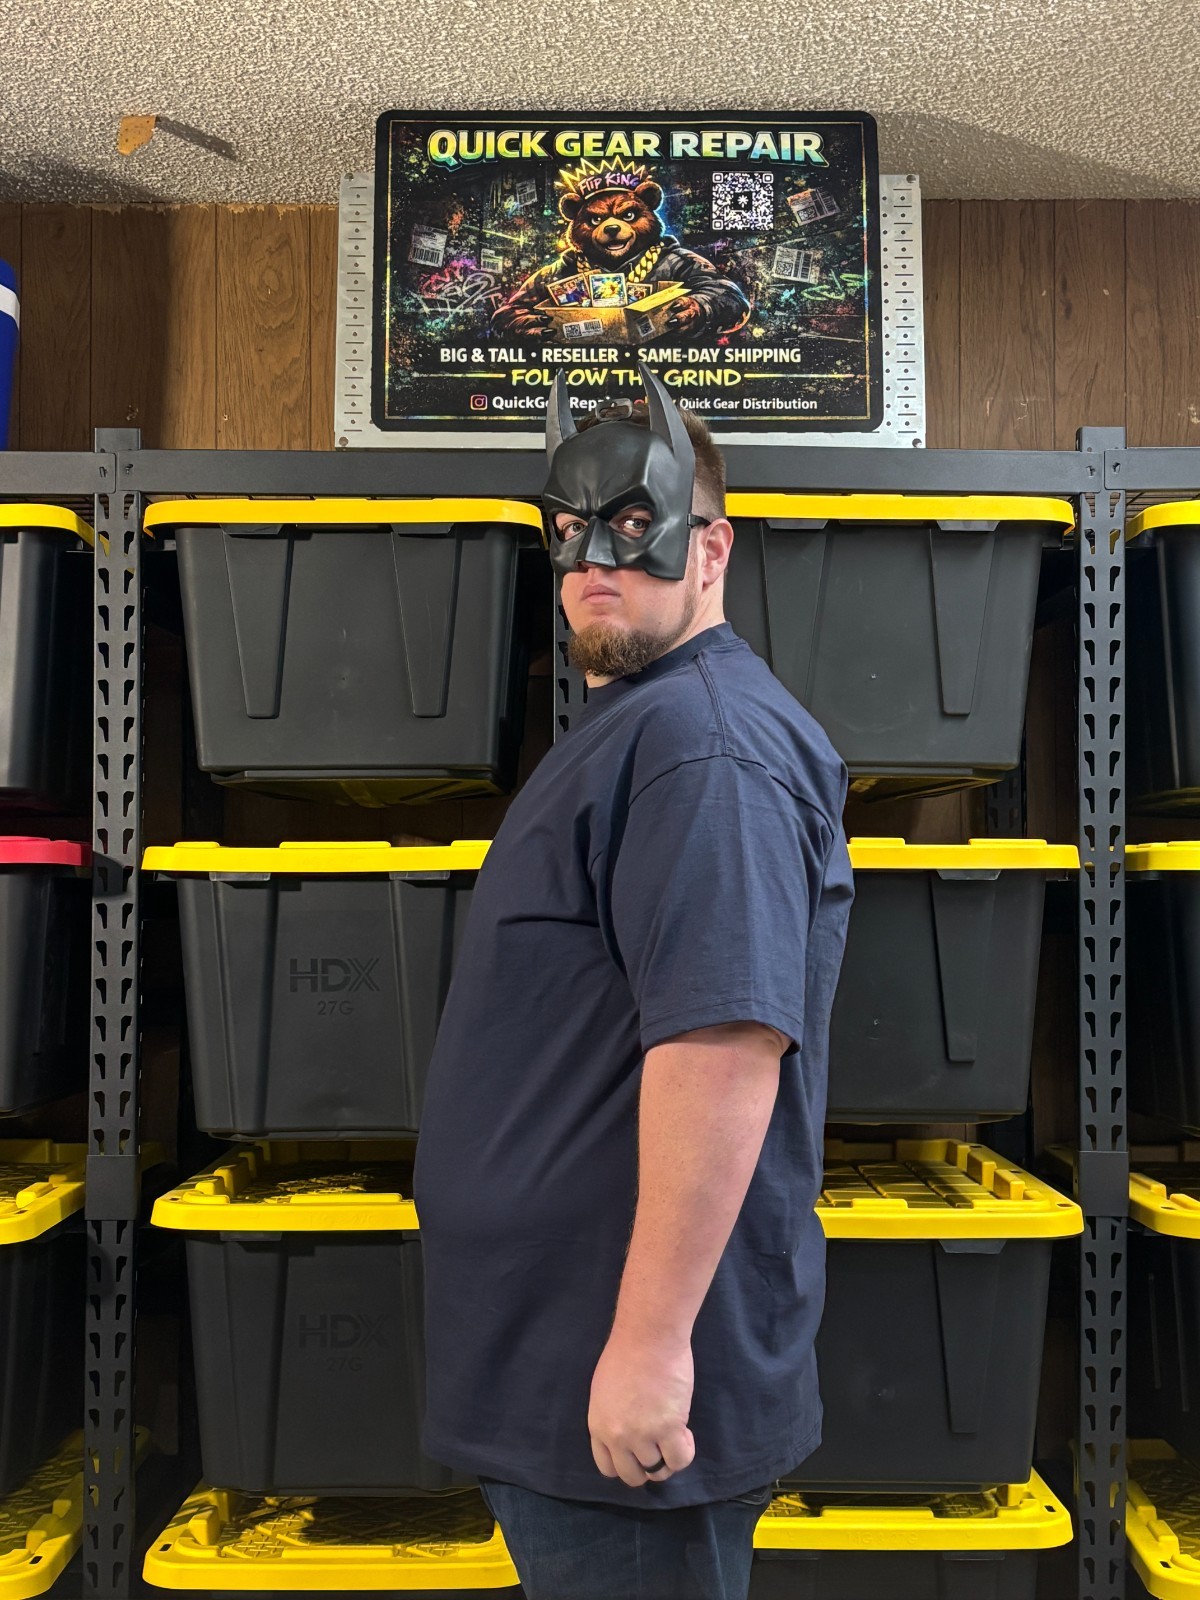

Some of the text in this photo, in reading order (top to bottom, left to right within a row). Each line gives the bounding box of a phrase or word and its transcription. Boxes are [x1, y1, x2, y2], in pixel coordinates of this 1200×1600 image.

[427, 130, 827, 167] QUICK GEAR REPAIR
[440, 348, 801, 363] BIG & TALL RESELLER SAME-DAY SHIPPING
[511, 368, 742, 388] FOLOW TH GRIND
[680, 397, 711, 410] Quick
[713, 397, 739, 410] Gear
[742, 397, 818, 410] Distribution
[289, 958, 380, 993] HDX
[317, 1000, 355, 1016] 27G
[299, 1313, 390, 1349] HDX
[327, 1356, 363, 1372] 27G
